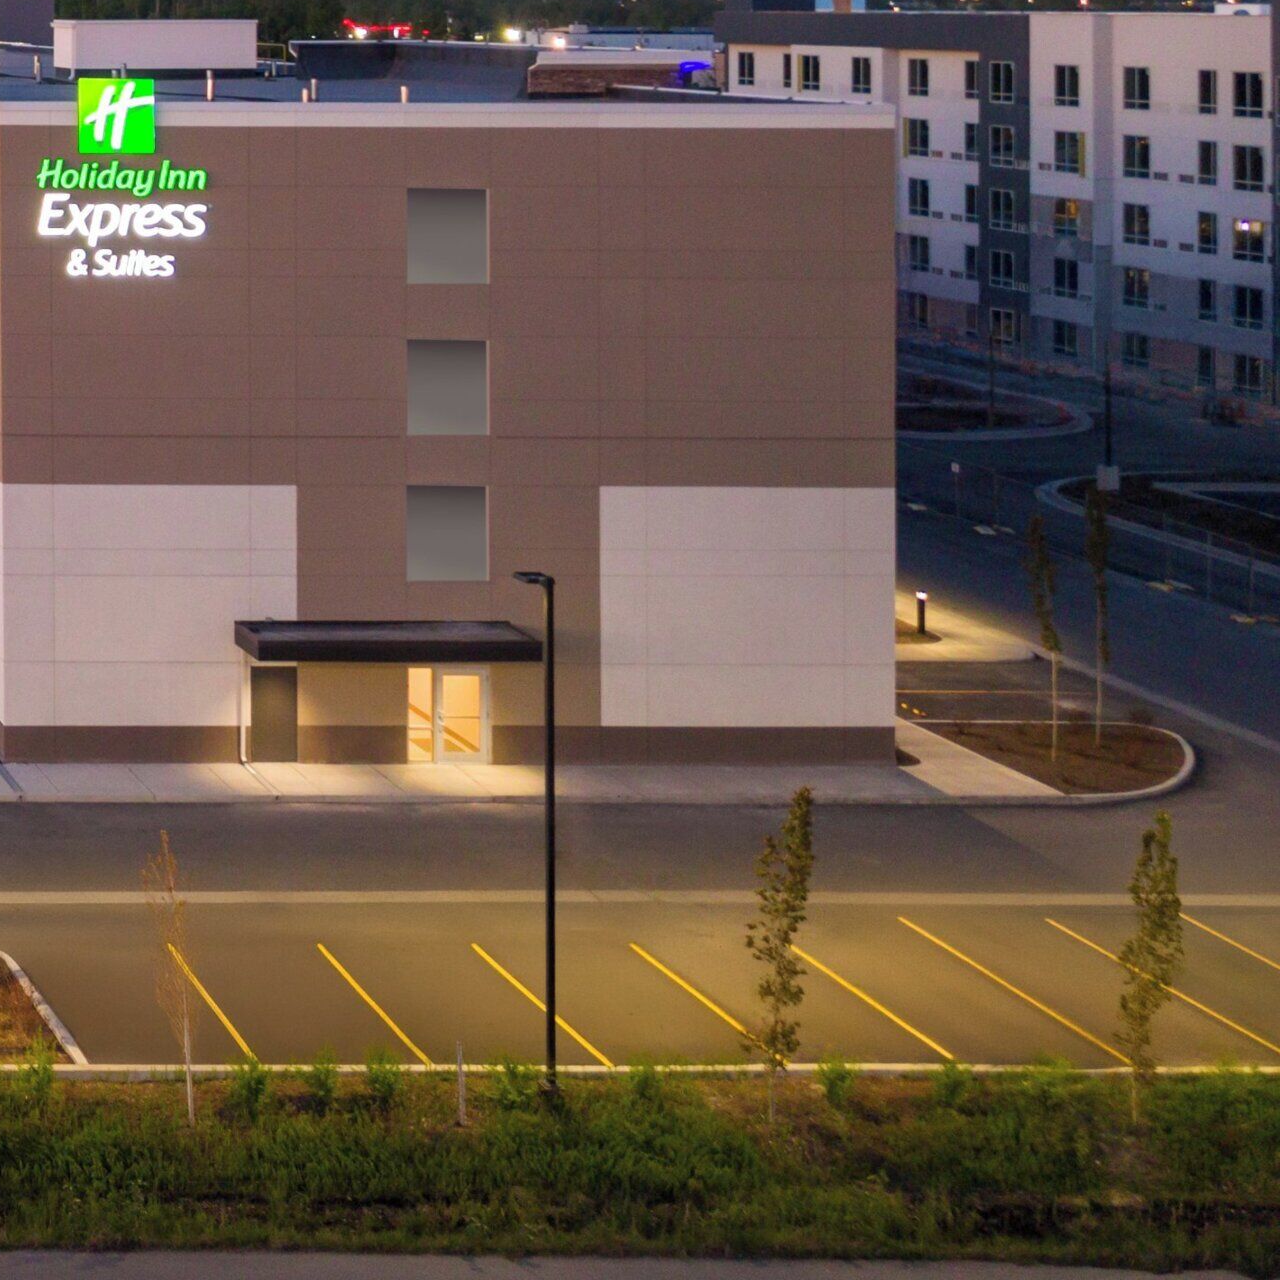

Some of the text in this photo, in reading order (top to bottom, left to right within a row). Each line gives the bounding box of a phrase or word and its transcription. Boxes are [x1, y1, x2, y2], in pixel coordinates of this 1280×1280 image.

[37, 159, 208, 197] Holiday Inn
[38, 193, 208, 247] Express
[66, 248, 176, 277] & Suites
